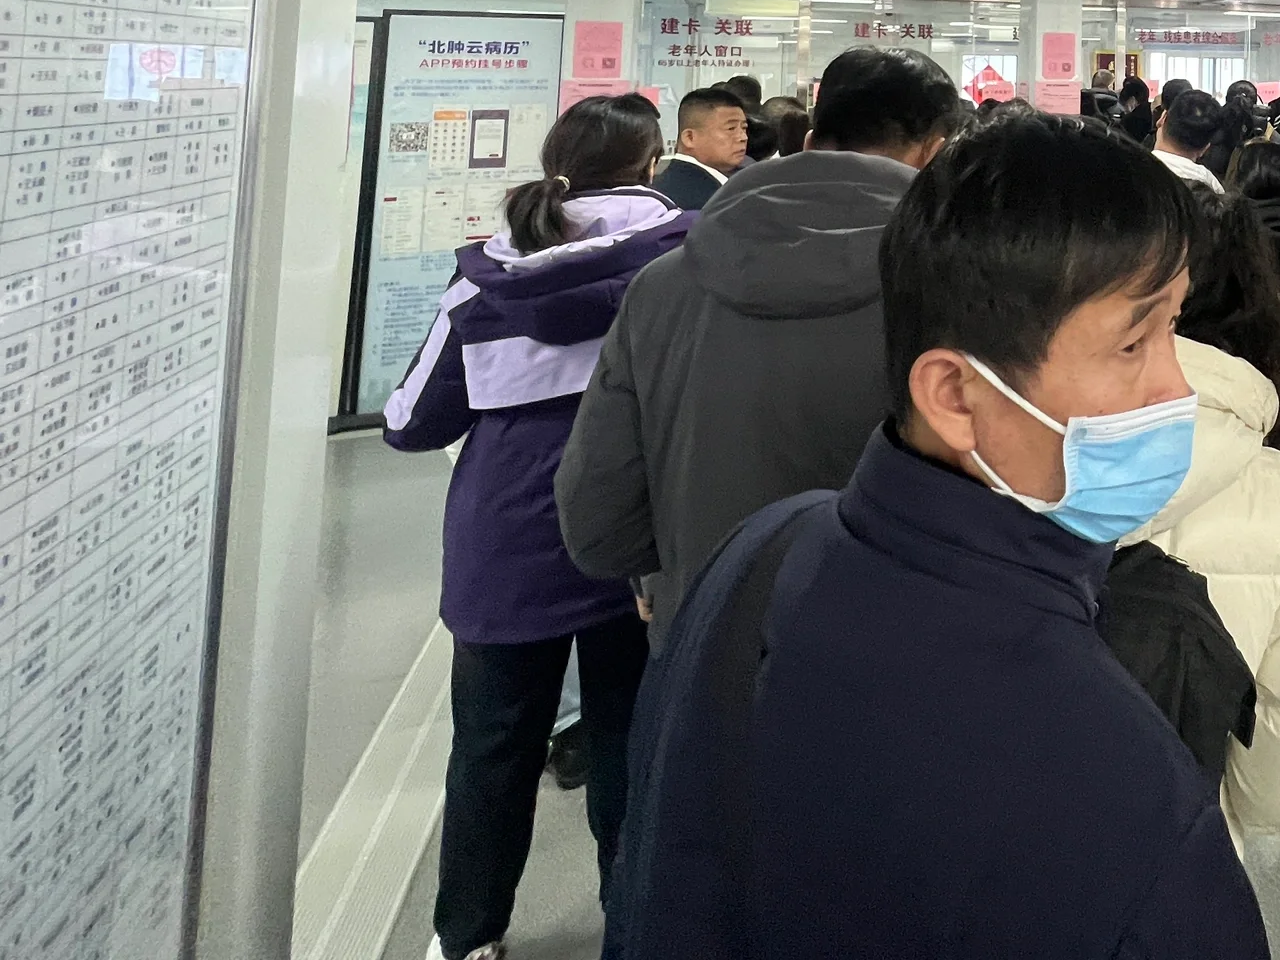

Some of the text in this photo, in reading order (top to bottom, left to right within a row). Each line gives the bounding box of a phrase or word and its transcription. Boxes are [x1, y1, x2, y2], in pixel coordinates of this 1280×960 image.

[661, 18, 753, 36] 建卡 关联
[854, 23, 933, 38] 建卡 关联
[668, 44, 742, 57] 老年人窗口
